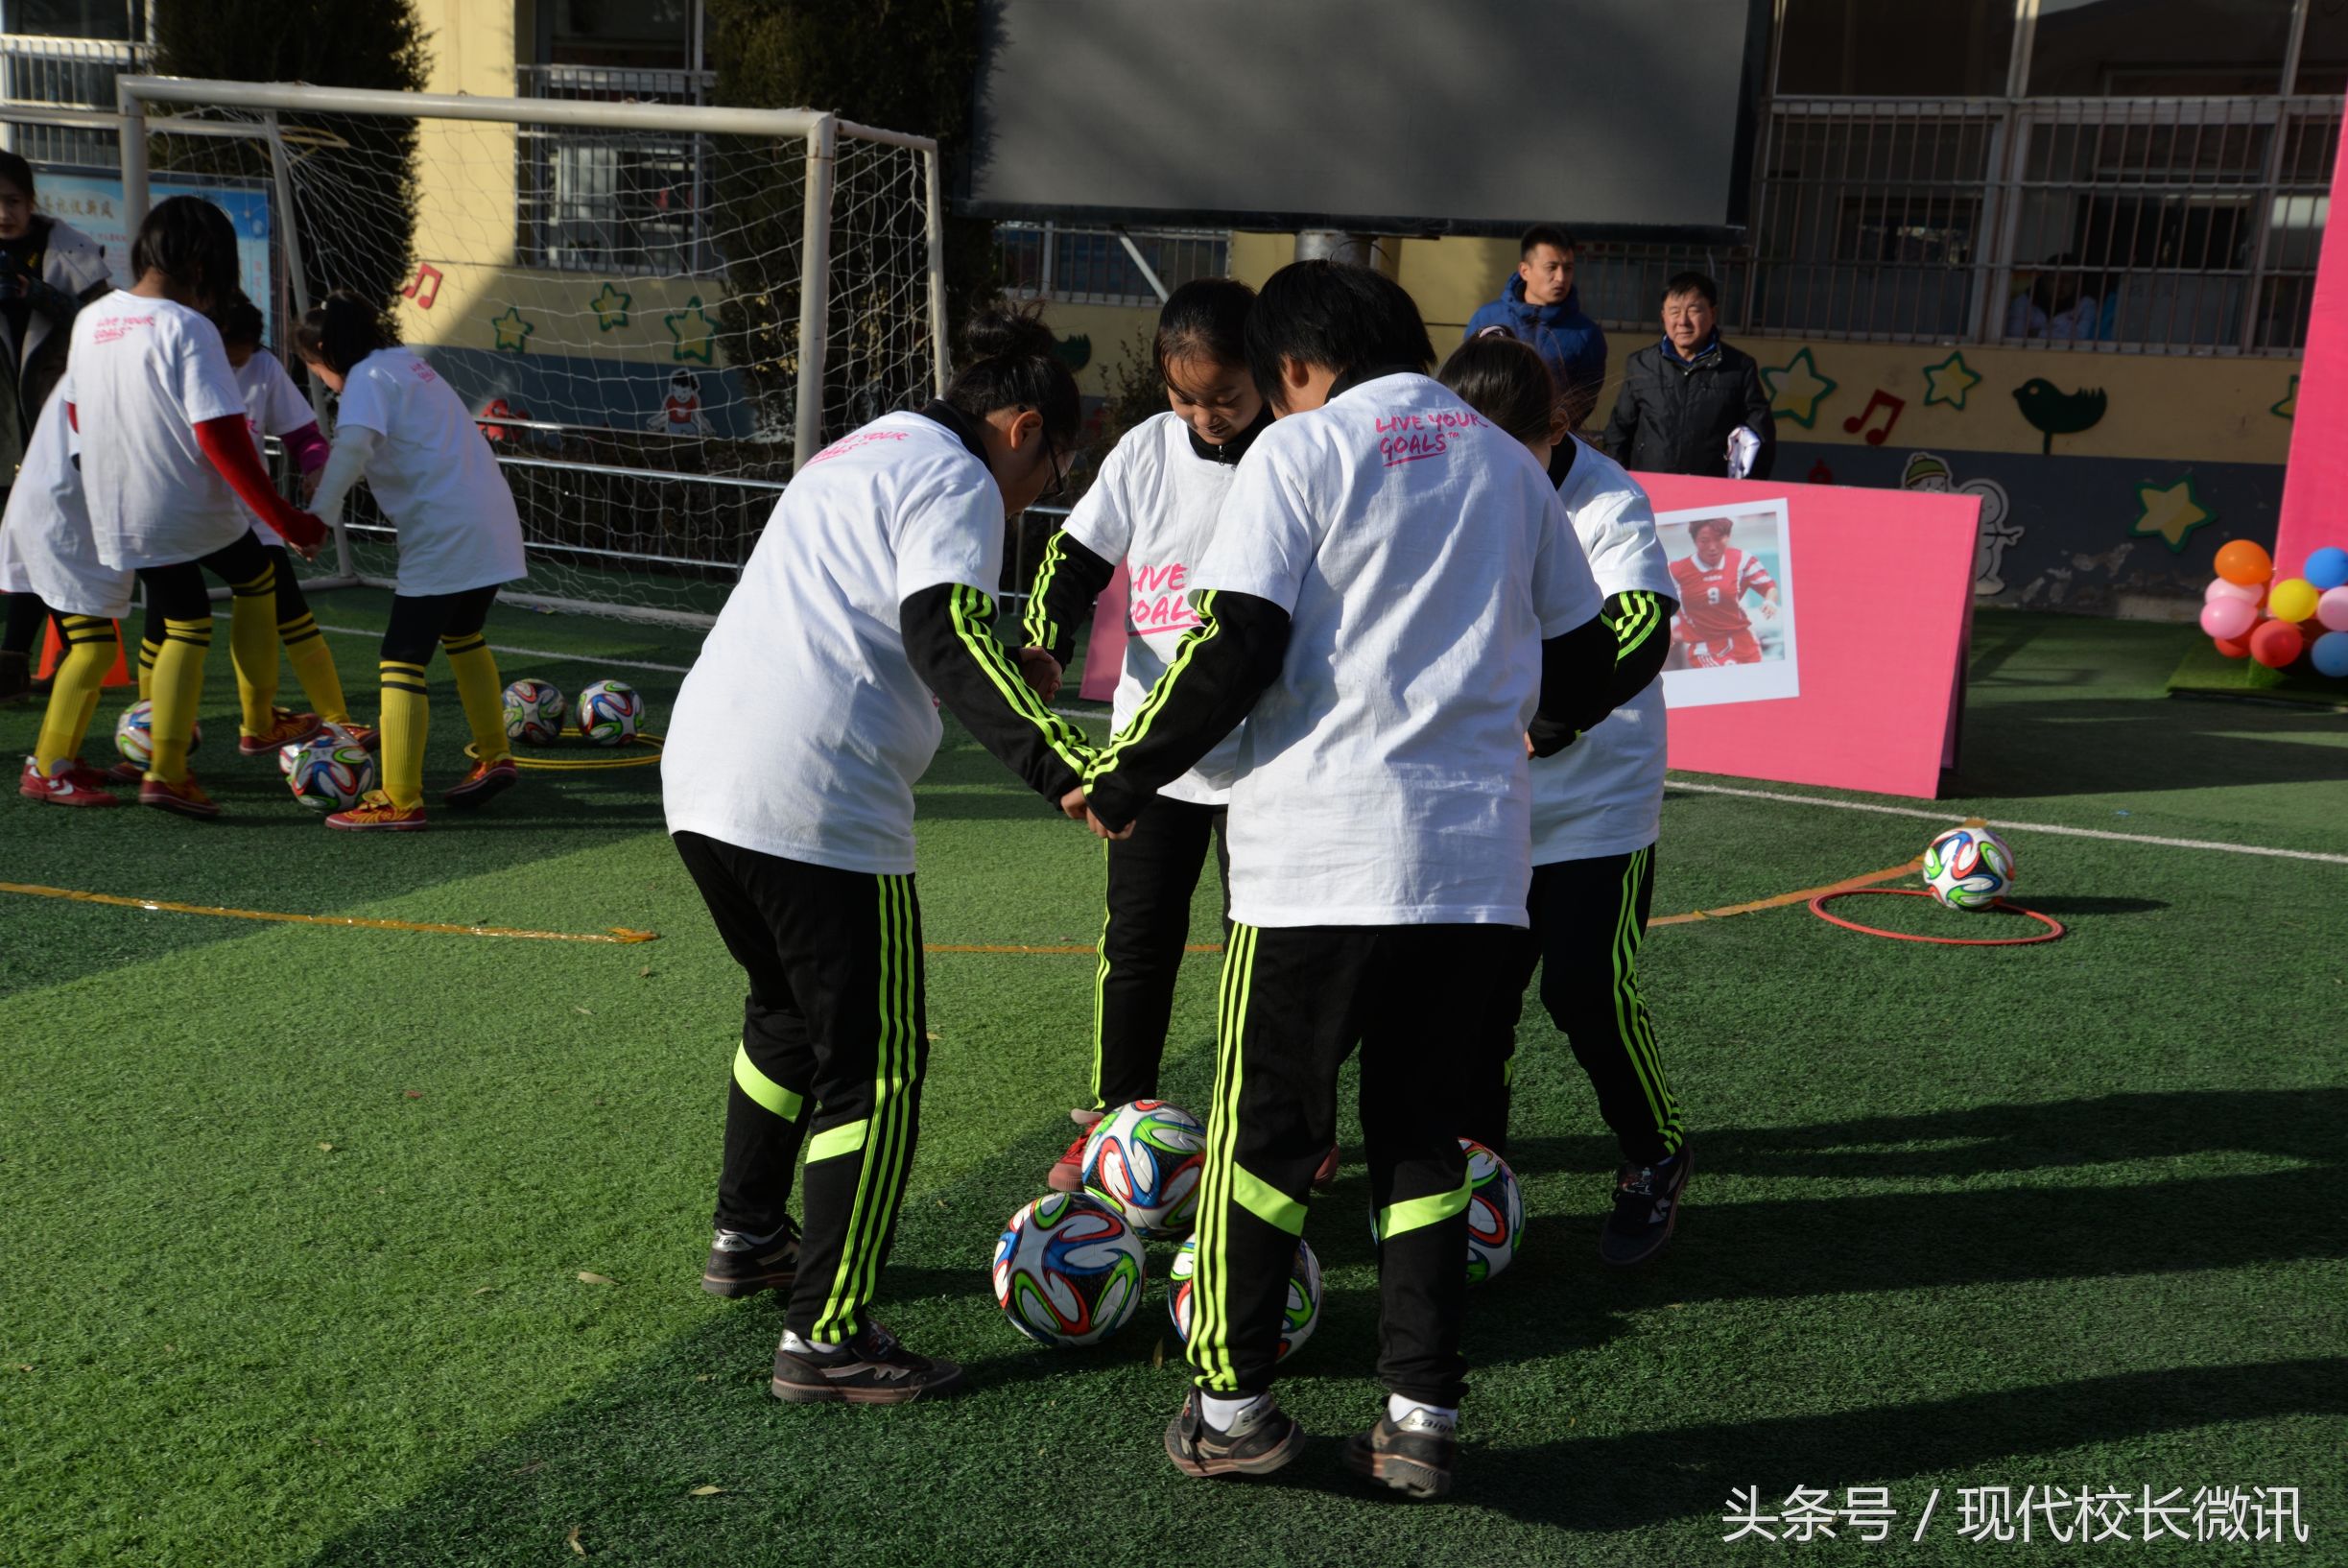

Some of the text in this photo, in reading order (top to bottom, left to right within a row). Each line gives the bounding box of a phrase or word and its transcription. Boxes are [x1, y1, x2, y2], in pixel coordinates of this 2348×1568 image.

[1375, 411, 1489, 433] LIVE YOUR
[1707, 586, 1720, 605] 9
[1131, 595, 1200, 625] OAL
